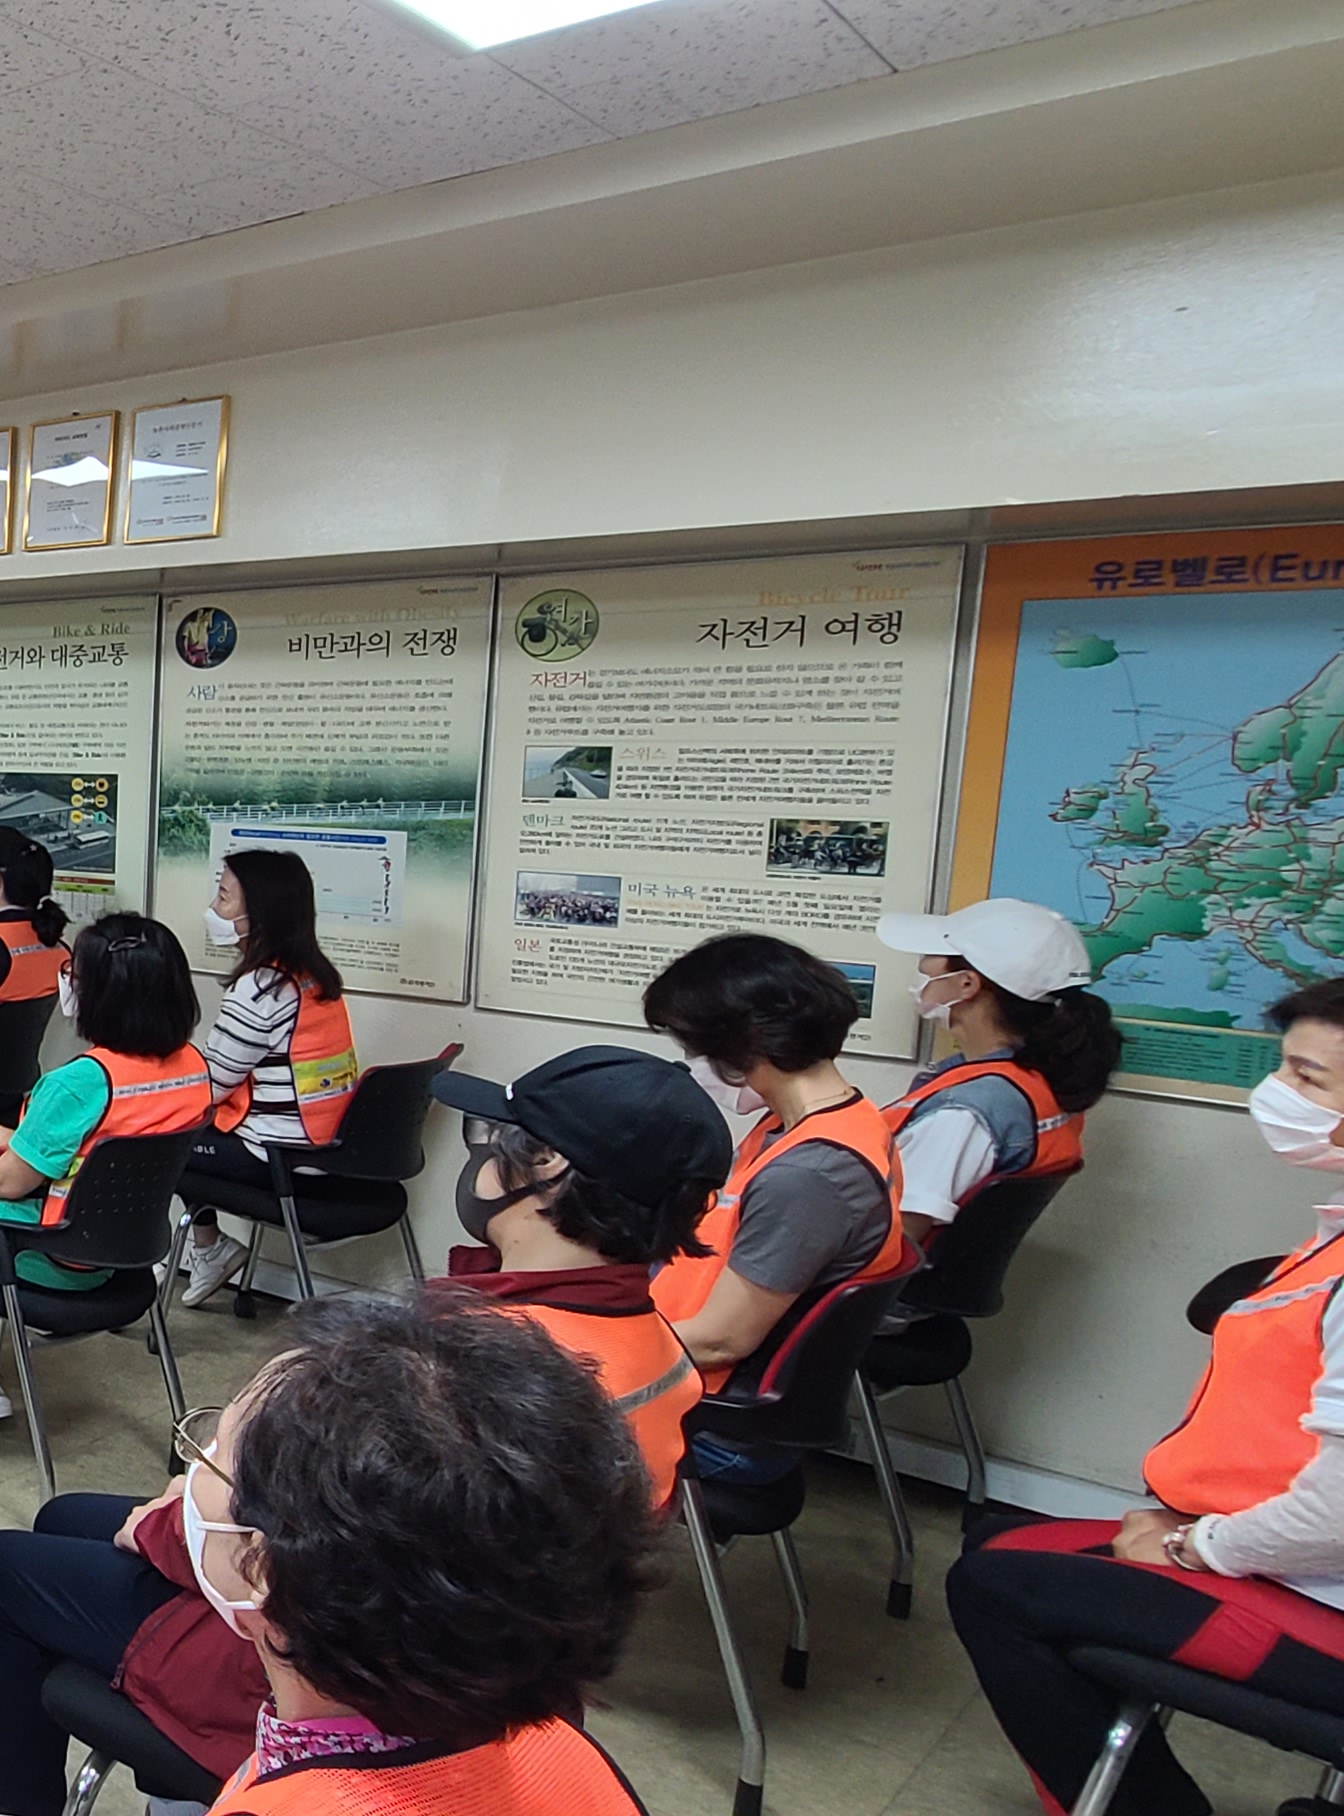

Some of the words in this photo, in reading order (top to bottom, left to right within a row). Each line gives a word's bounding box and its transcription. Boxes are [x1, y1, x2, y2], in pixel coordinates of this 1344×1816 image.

[758, 588, 841, 609] Bicycle
[853, 585, 910, 602] Tour
[52, 625, 80, 638] Bike
[84, 625, 96, 637] &
[100, 622, 131, 636] Ride
[695, 614, 807, 650] 자전거
[823, 609, 904, 646] 여행
[287, 629, 391, 660] 비만과의
[402, 626, 459, 657] 전쟁
[51, 642, 129, 668] 대중교통
[530, 671, 588, 689] 자전거
[186, 684, 217, 701] 사람
[619, 746, 667, 760] 스위스
[523, 813, 565, 829] 덴마크
[628, 882, 659, 897] 미국
[663, 884, 697, 900] 뉴욕
[514, 938, 542, 953] 일본
